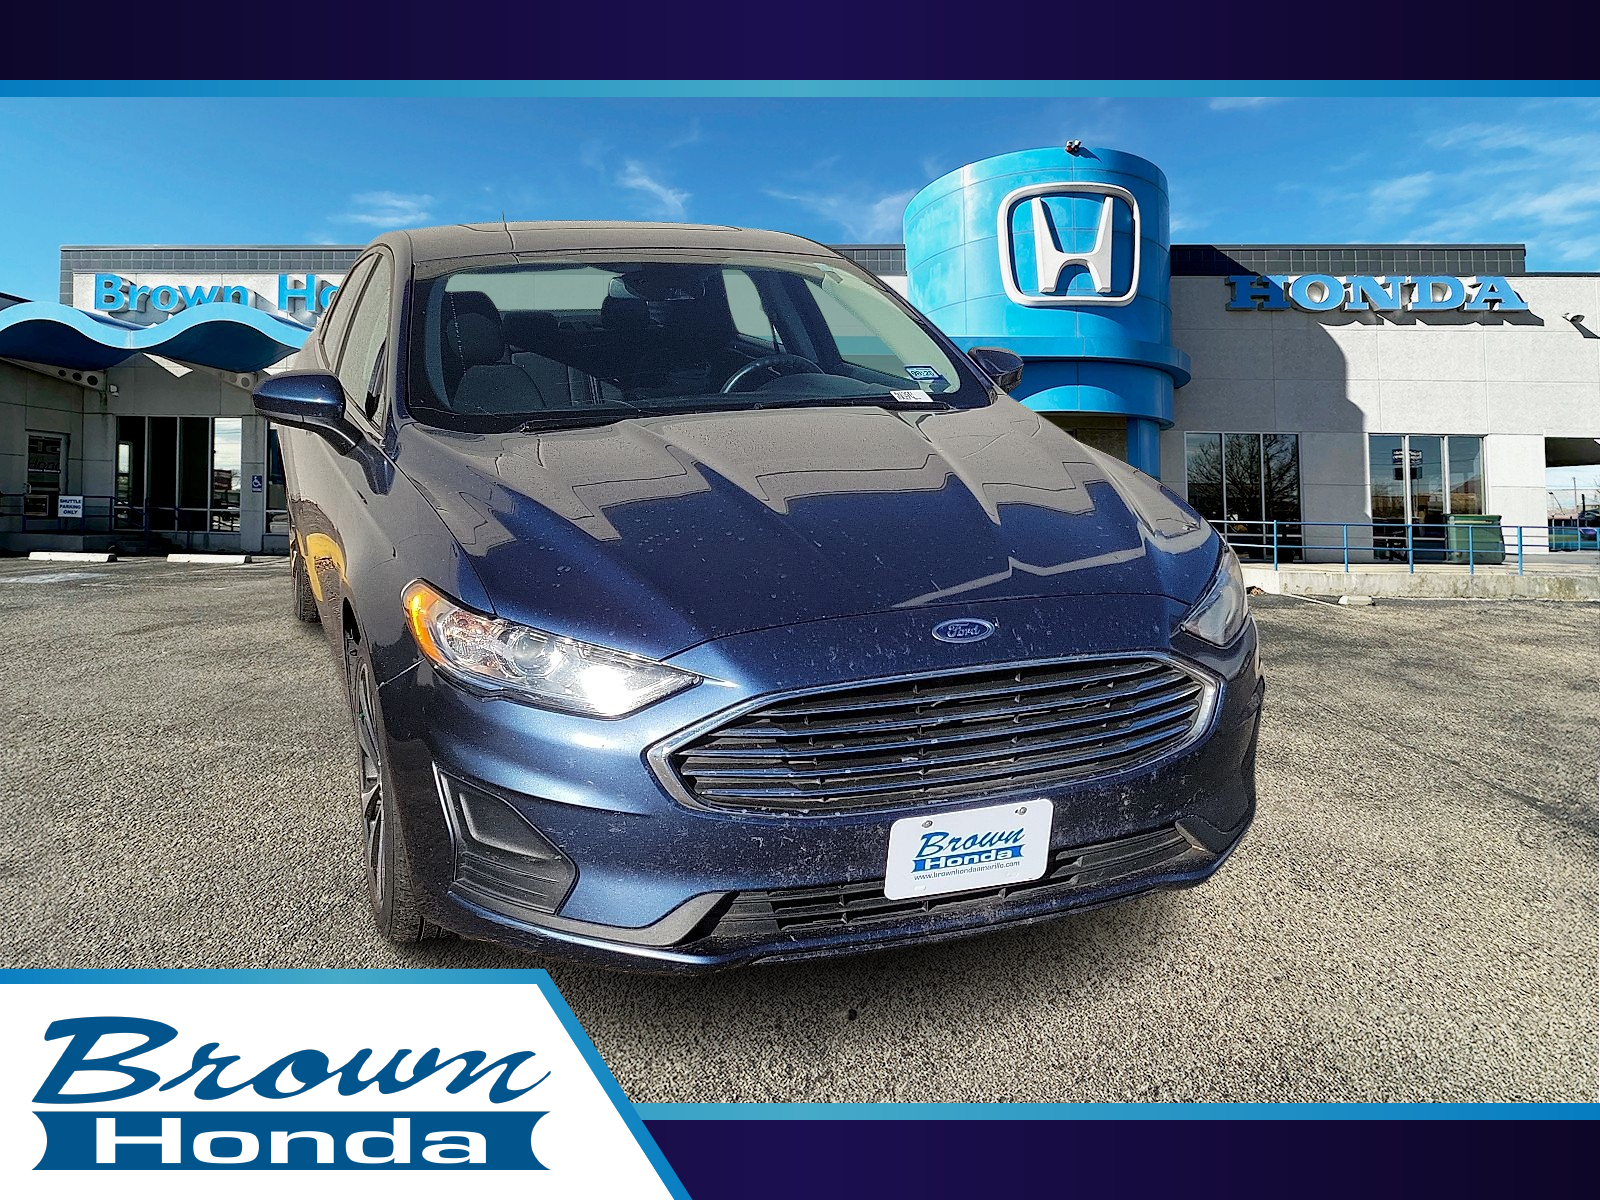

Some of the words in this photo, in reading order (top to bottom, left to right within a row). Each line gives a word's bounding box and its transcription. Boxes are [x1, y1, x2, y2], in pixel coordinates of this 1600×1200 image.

[94, 273, 249, 311] Brown
[1227, 274, 1529, 312] HONDA
[947, 622, 980, 638] Ford
[915, 827, 1026, 859] Brown
[924, 848, 1013, 871] Honda
